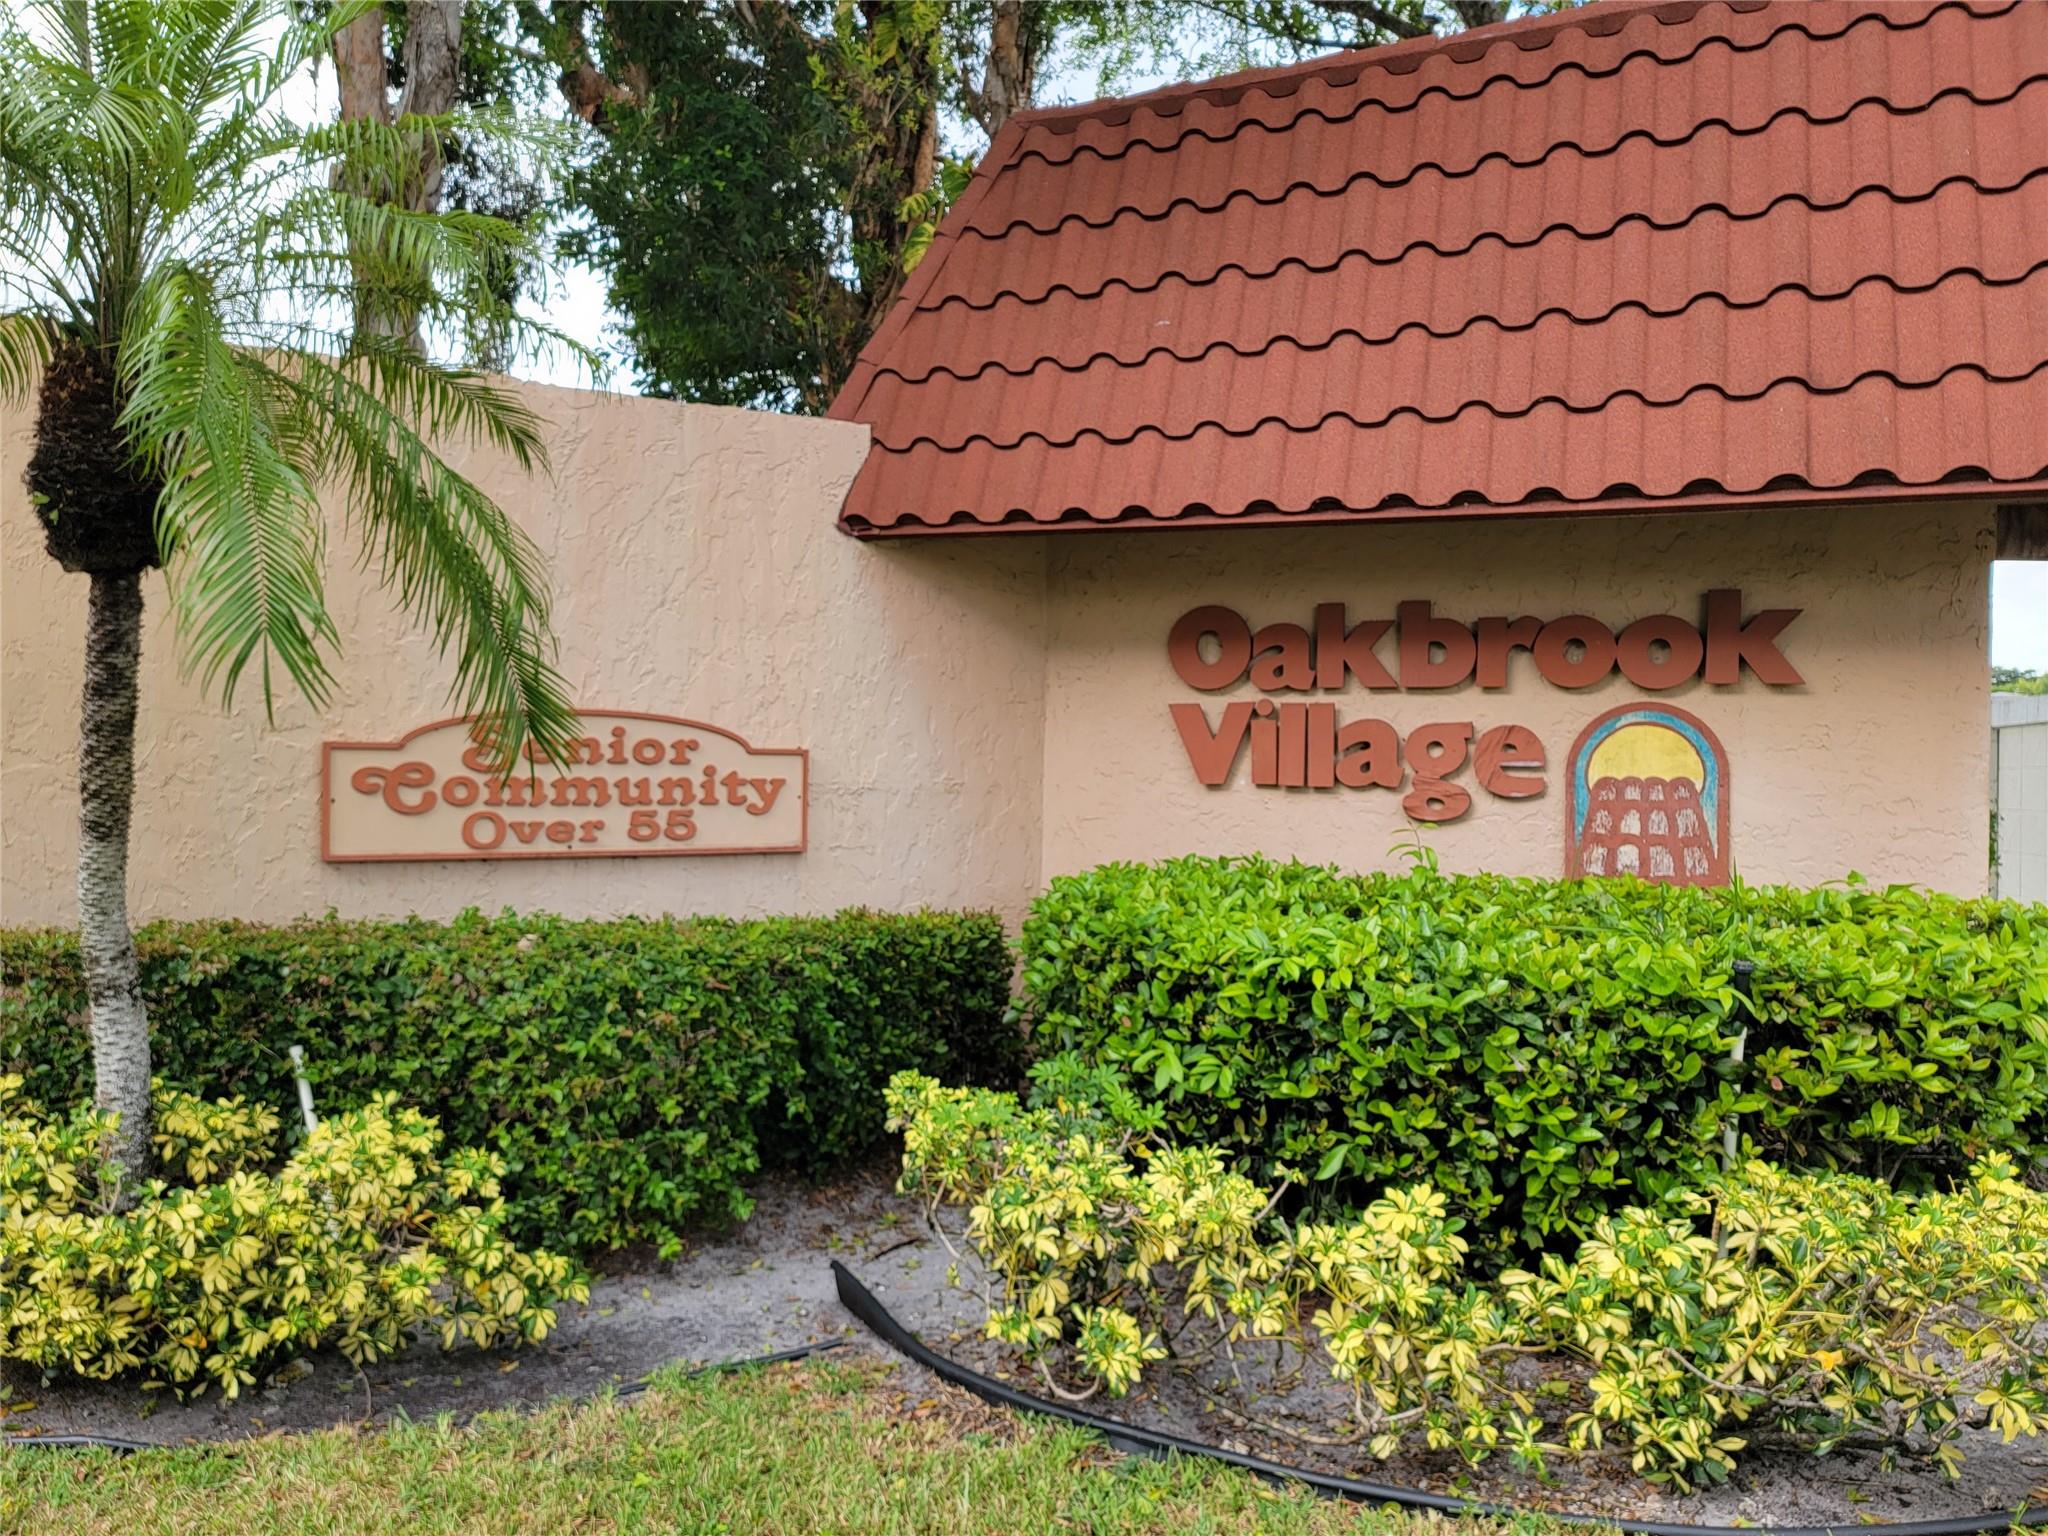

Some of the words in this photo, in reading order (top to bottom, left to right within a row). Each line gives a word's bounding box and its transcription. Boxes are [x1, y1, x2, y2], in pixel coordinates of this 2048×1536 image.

[1167, 589, 1806, 690] Oakbrook
[351, 761, 786, 815] Community
[1168, 699, 1545, 821] Village
[461, 811, 605, 850] Over
[627, 809, 698, 842] 55
